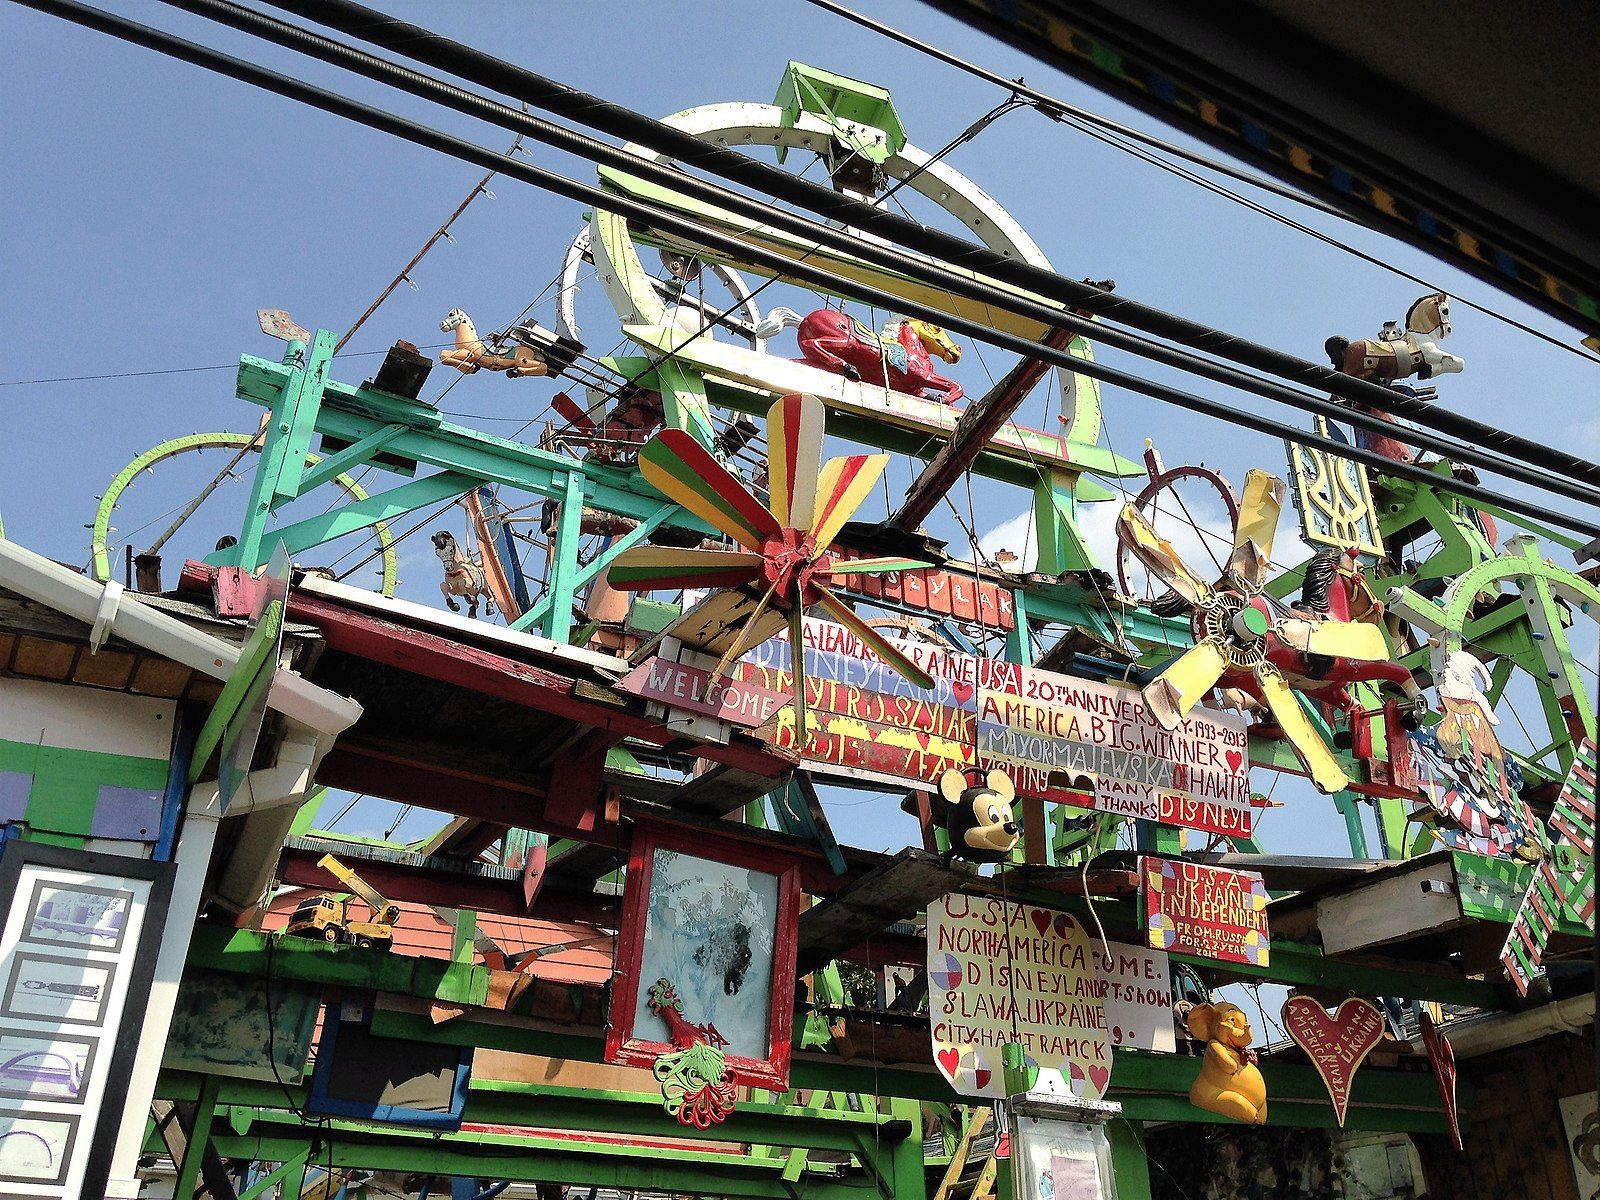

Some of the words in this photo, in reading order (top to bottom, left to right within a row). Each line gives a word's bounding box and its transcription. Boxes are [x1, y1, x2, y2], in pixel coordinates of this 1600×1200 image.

[756, 640, 951, 703] DINEYLAND
[879, 643, 975, 683] RAINE
[649, 663, 775, 721] WELCOME
[1097, 777, 1154, 800] MANY
[1101, 794, 1158, 820] THANKS
[1176, 878, 1252, 910] UKRAINE
